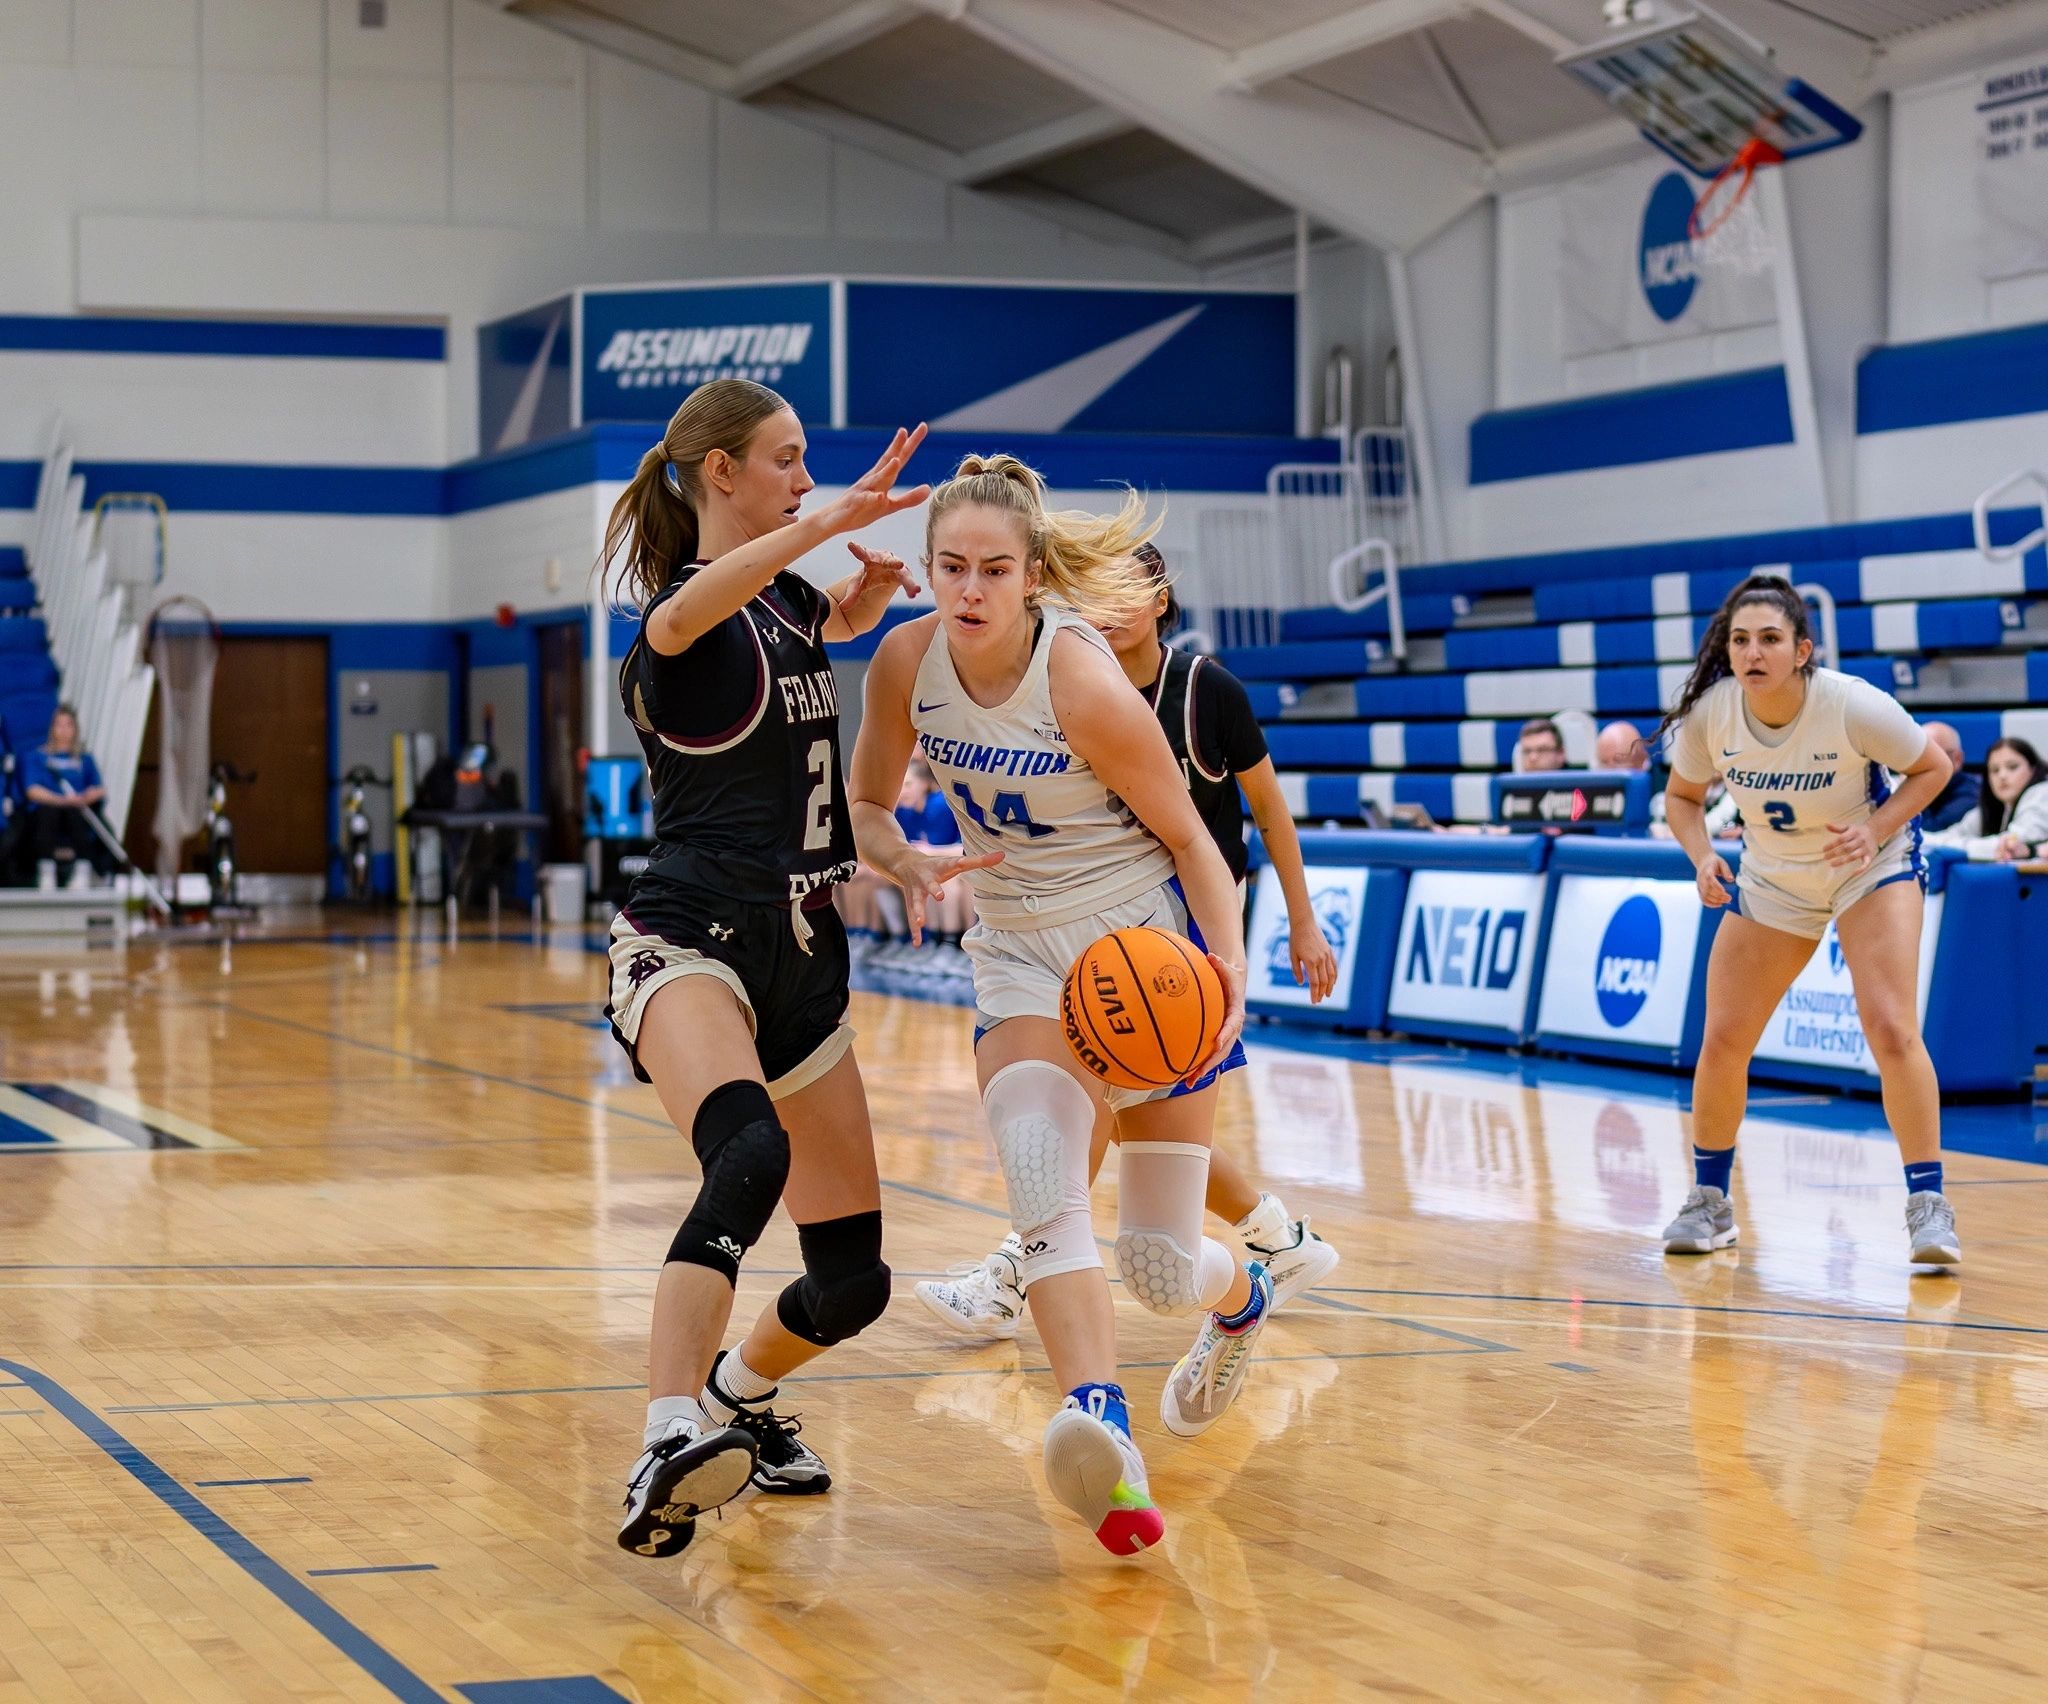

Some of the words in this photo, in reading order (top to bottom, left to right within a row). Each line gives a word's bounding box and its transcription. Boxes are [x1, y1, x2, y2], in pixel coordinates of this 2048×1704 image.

[597, 323, 812, 371] ASSUMPTION
[918, 732, 1073, 777] ASSUMPTION
[803, 739, 832, 850] 2
[1727, 767, 1836, 791] ASSUMPTION
[951, 779, 1060, 840] 14
[1764, 802, 1796, 832] 2
[1406, 904, 1526, 989] NE10
[1600, 955, 1656, 995] NCAA
[1094, 976, 1135, 1034] EVO
[1784, 1017, 1866, 1061] University
